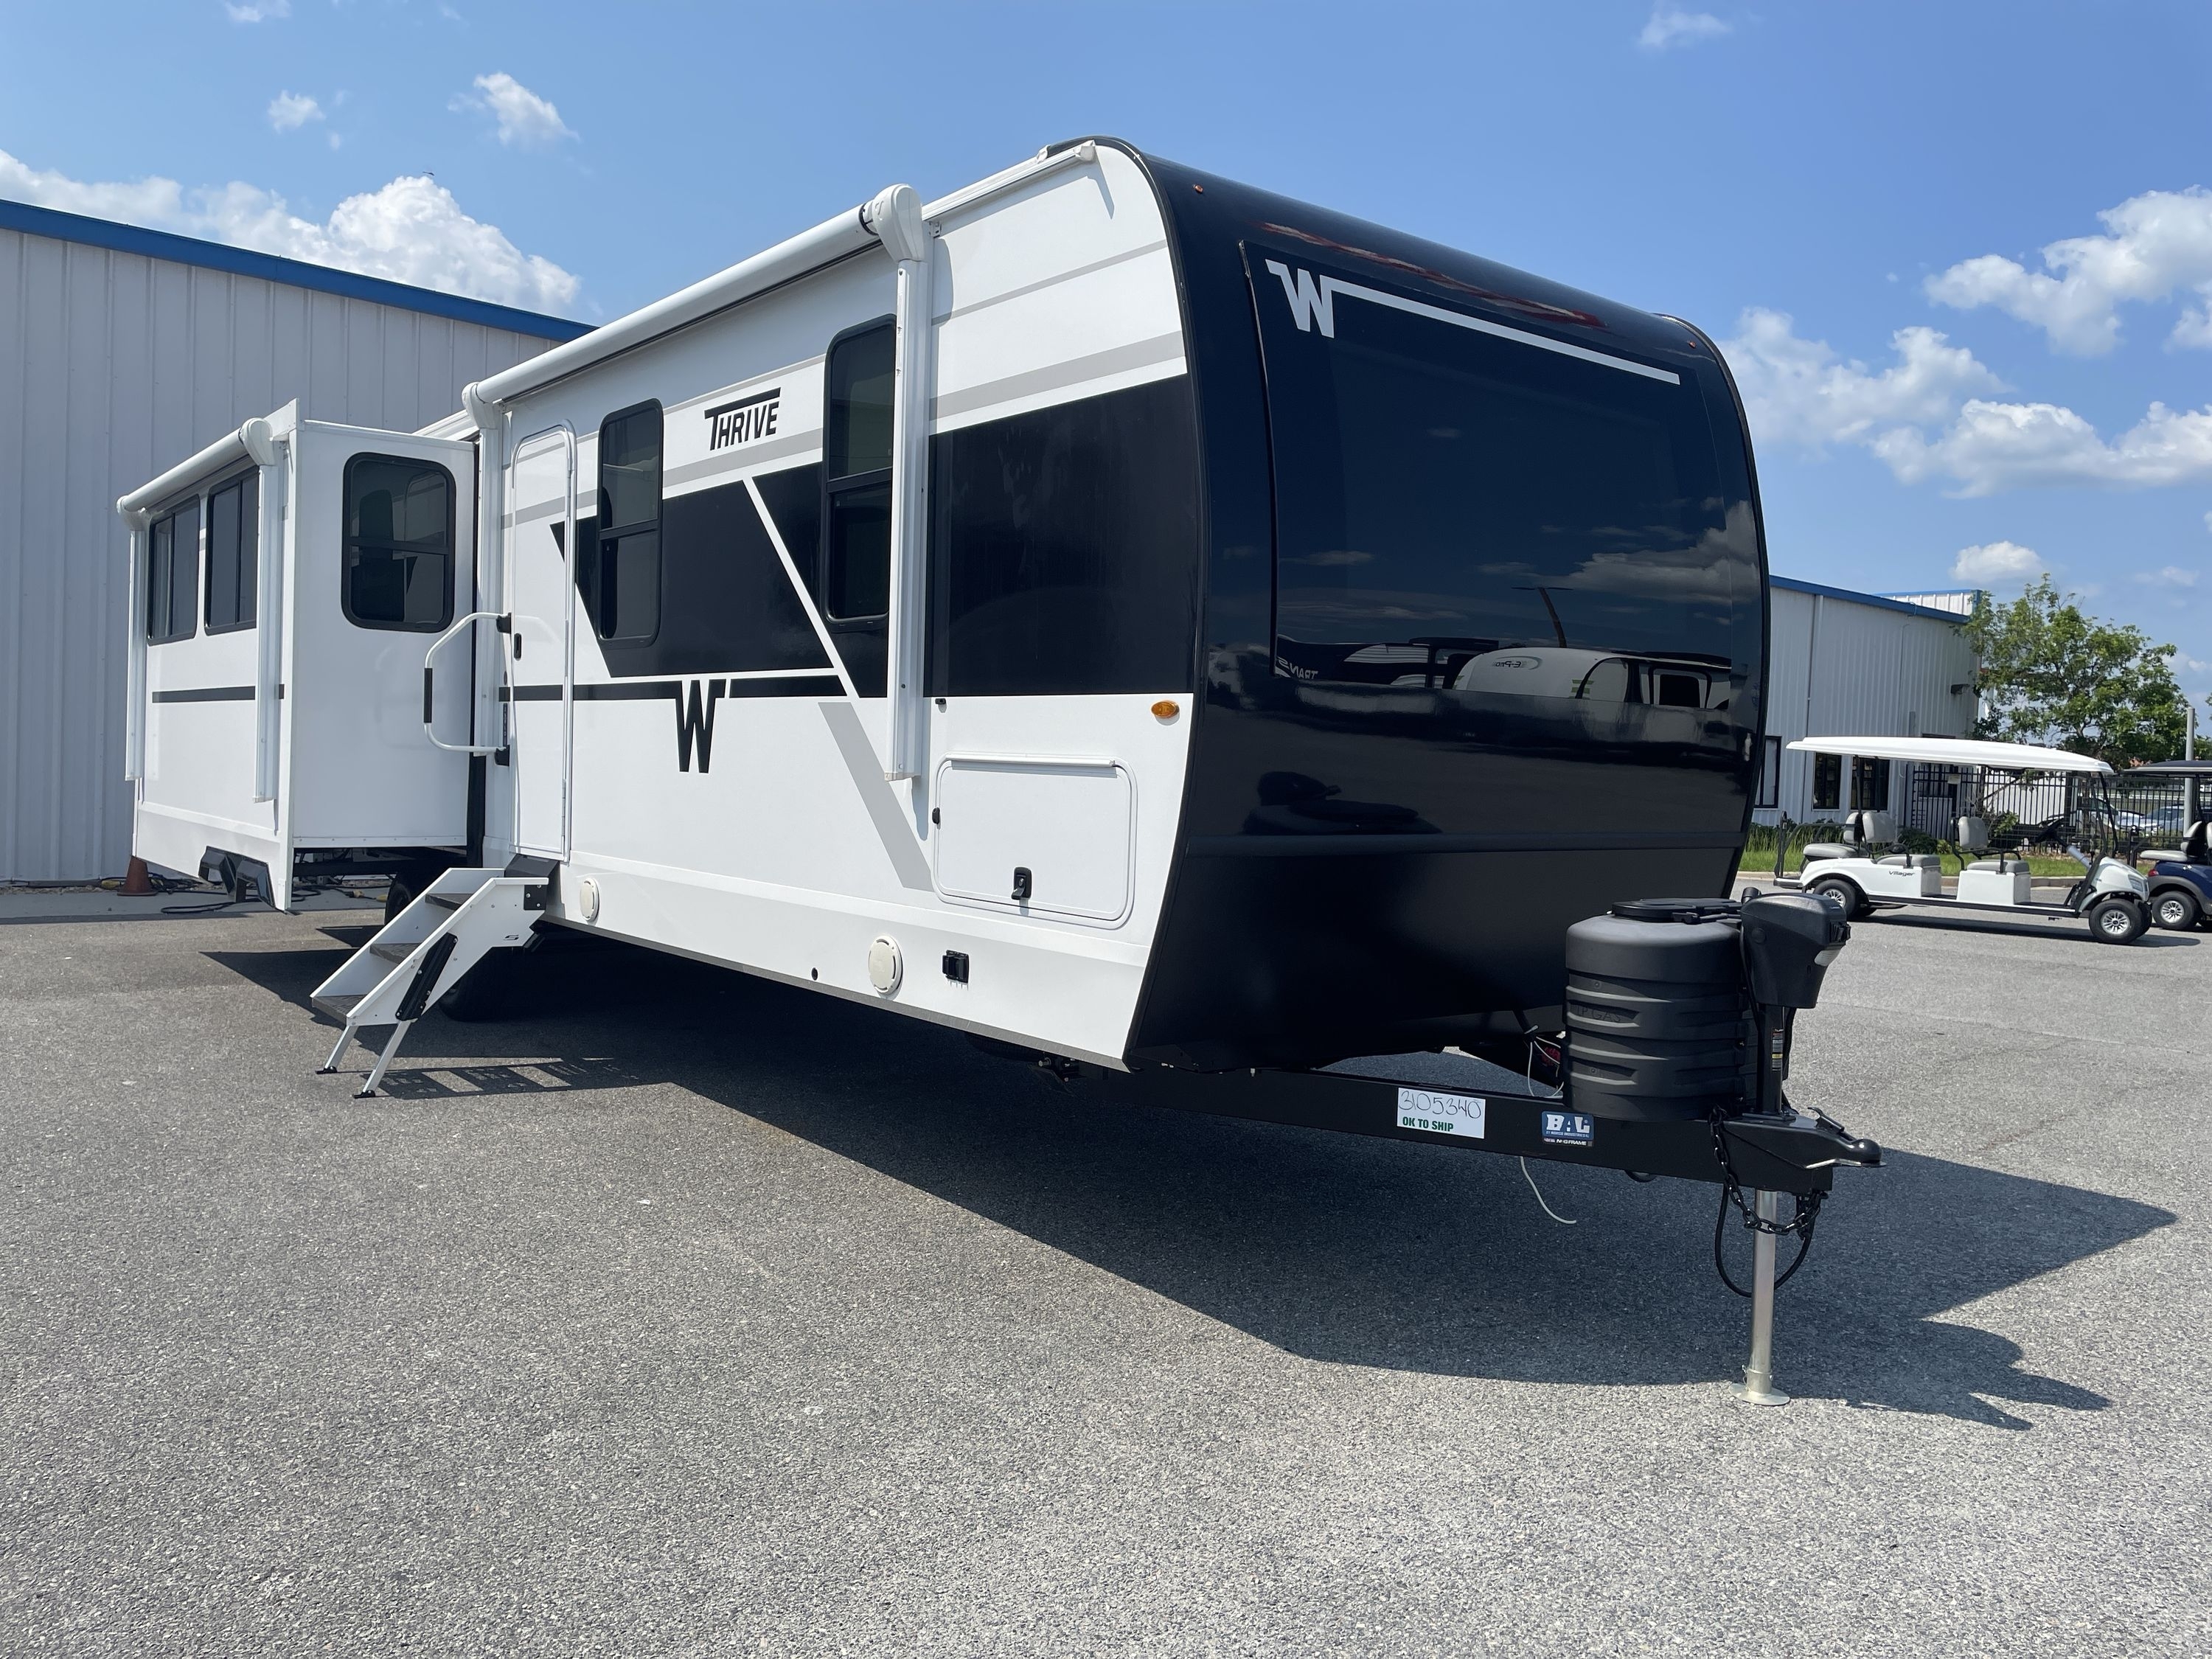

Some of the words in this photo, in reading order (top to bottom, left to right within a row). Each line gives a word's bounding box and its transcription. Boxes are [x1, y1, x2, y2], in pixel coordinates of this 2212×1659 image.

[1265, 259, 1335, 338] W
[704, 387, 781, 451] THRIVE
[675, 678, 727, 773] W
[1399, 1091, 1481, 1119] 3105340
[1402, 1116, 1416, 1127] OK
[1418, 1119, 1429, 1129] TO
[1431, 1120, 1454, 1132] SHIP
